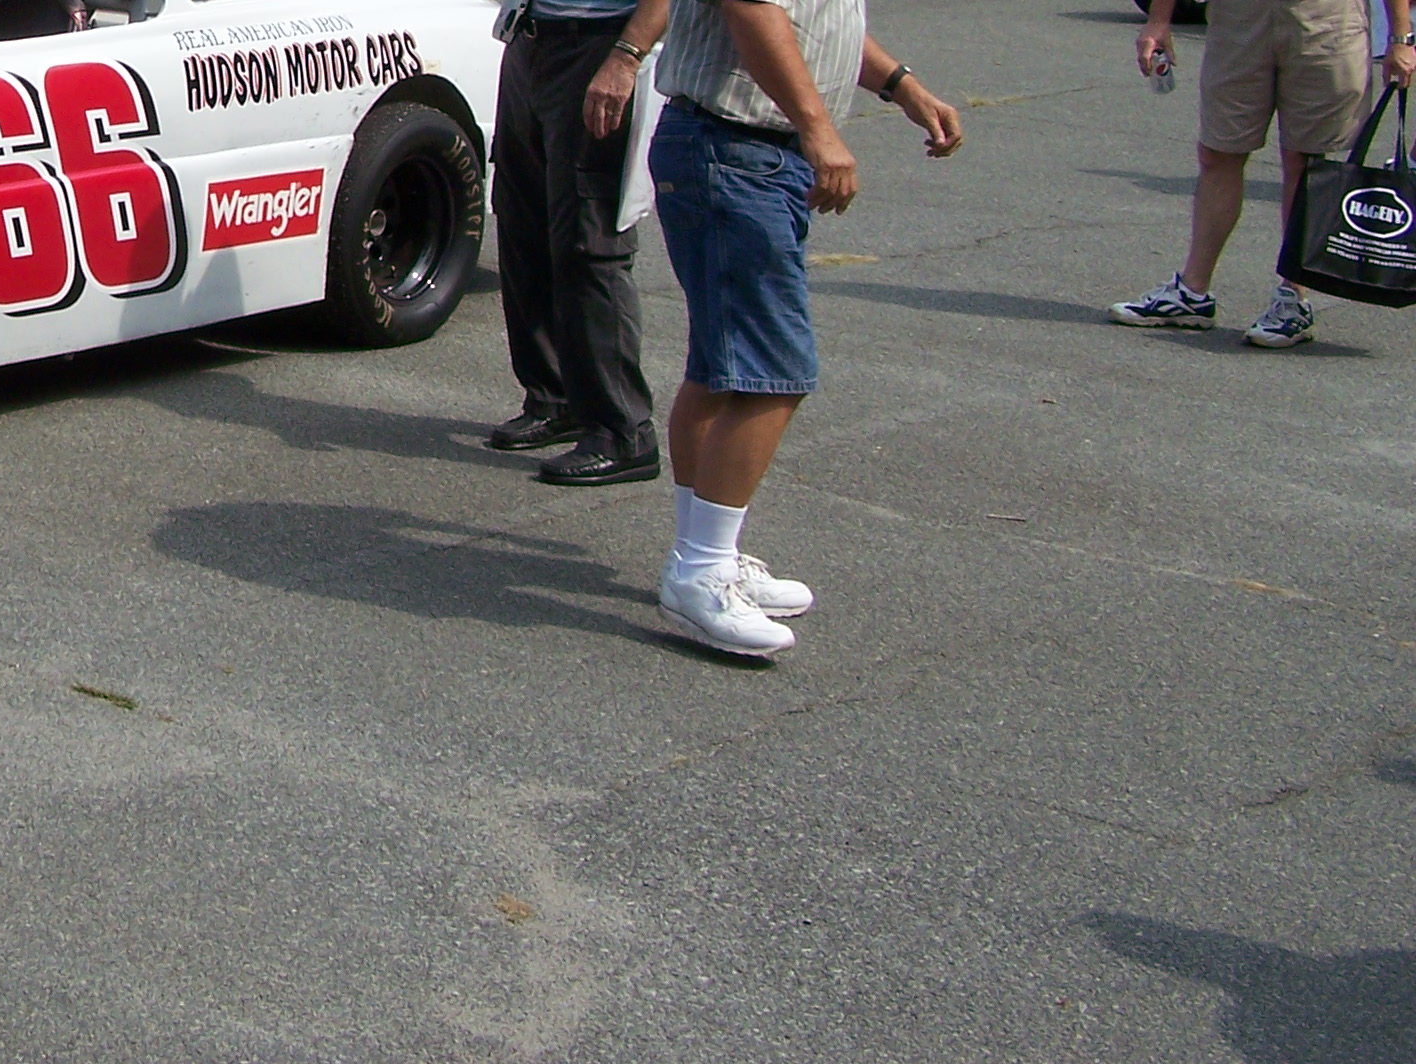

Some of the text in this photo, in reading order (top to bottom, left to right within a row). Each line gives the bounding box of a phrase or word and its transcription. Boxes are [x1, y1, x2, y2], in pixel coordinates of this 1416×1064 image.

[173, 28, 224, 51] REAL
[227, 18, 314, 45] AMERICAN
[183, 29, 424, 112] HUDSON MOTOR CARS
[209, 182, 321, 236] Wrangler
[1349, 200, 1405, 224] HAGEY
